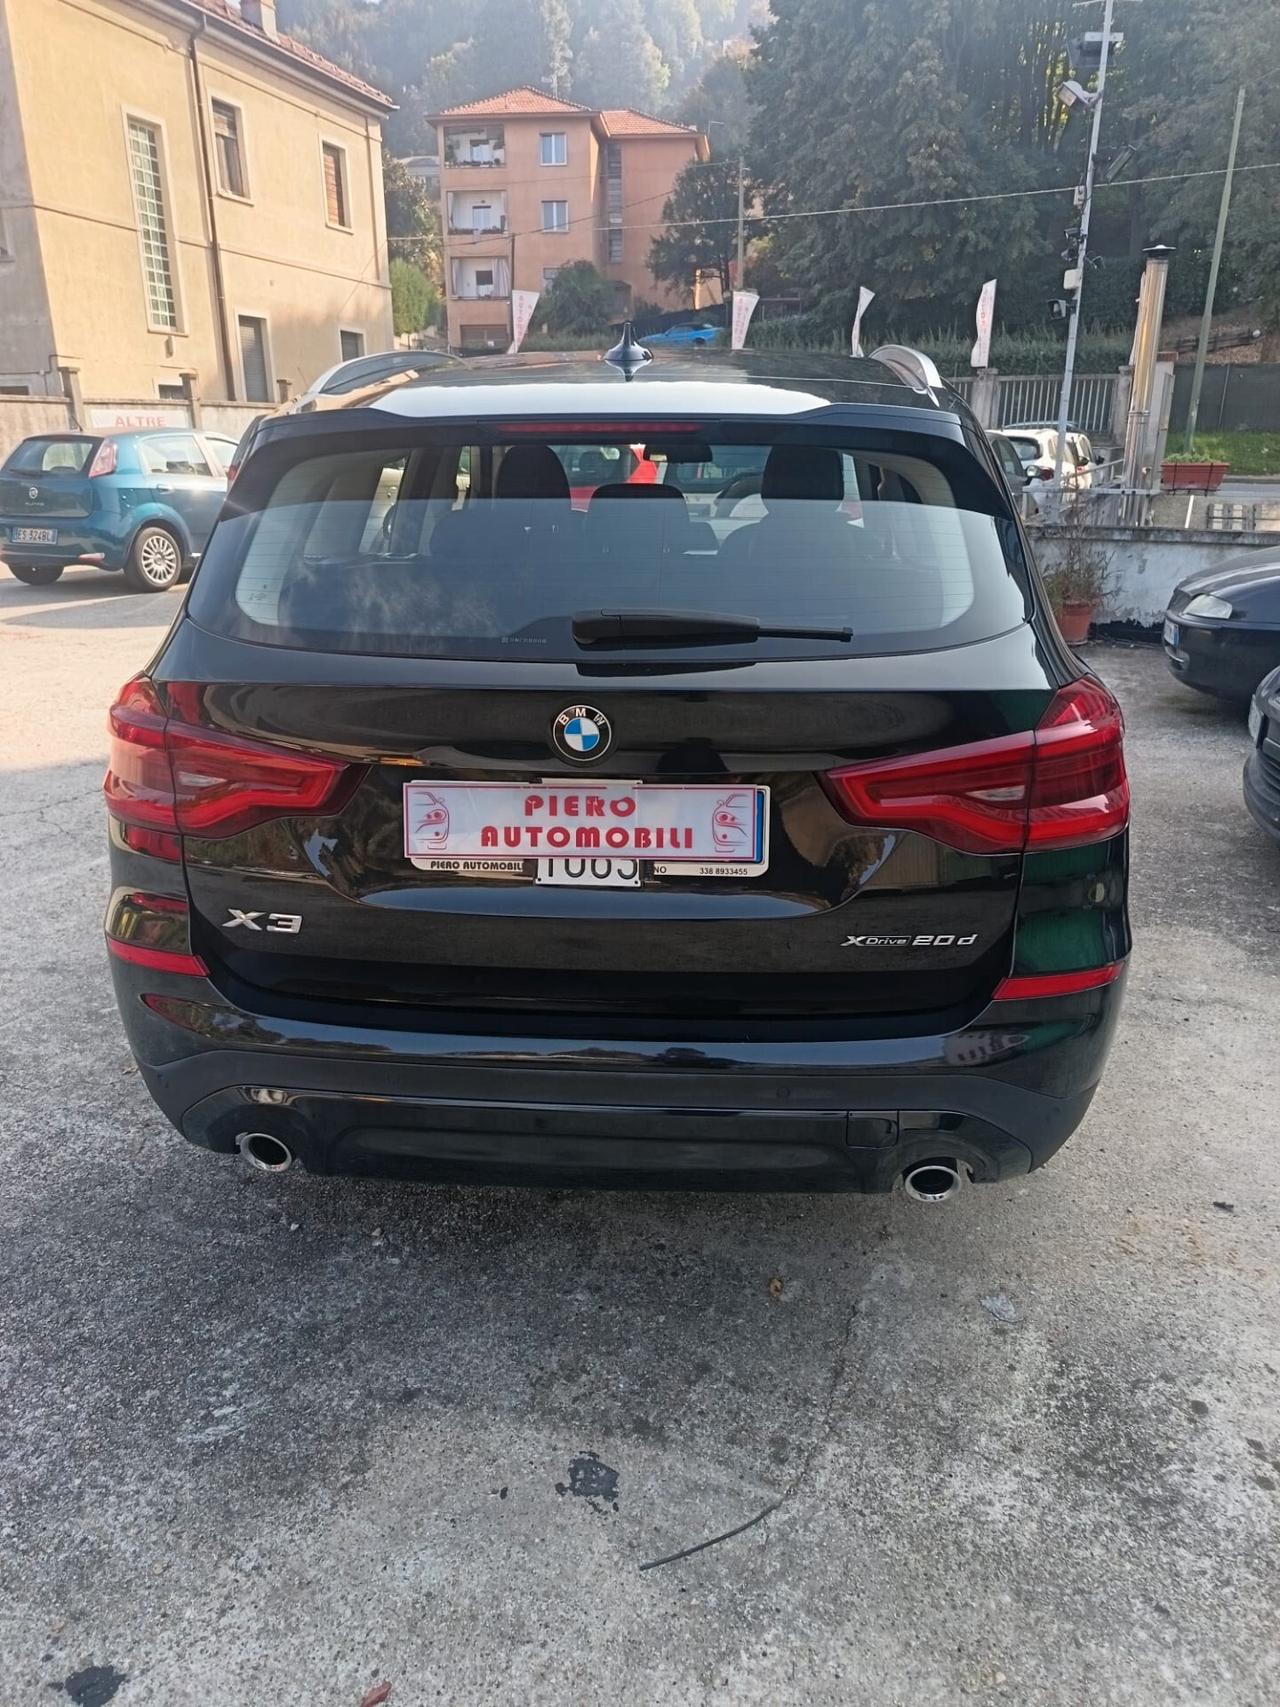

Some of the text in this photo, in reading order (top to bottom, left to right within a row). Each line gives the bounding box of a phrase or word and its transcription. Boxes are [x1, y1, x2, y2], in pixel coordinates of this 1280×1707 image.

[115, 415, 166, 427] ALTRE
[558, 707, 606, 726] BMW
[525, 794, 636, 818] PIERO
[481, 826, 693, 849] AUTOMOBILI
[430, 860, 460, 870] PIERO
[699, 867, 748, 876] 338 8933455
[221, 908, 303, 934] X3
